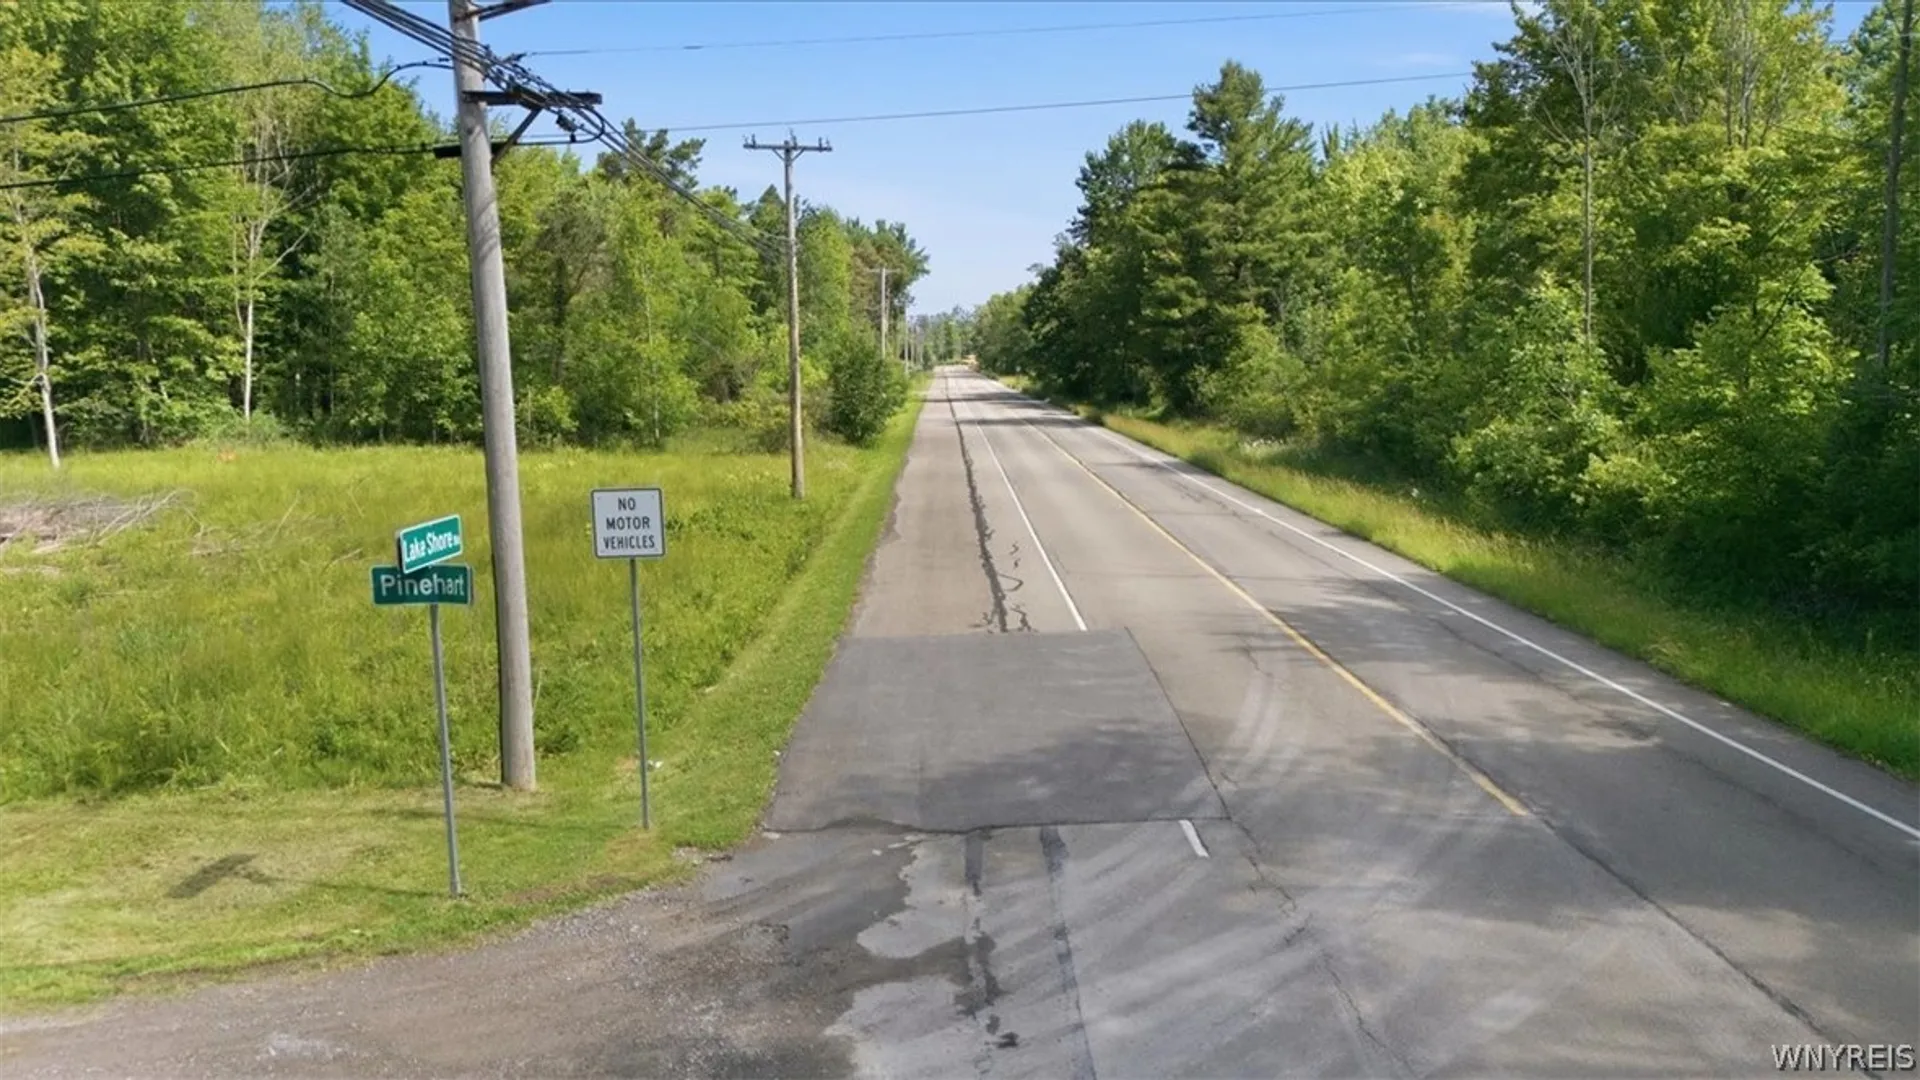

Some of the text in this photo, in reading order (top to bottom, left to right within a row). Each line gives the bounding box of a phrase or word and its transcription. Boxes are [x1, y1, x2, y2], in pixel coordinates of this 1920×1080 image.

[618, 497, 636, 511] NO
[606, 516, 650, 531] MOTOR
[403, 537, 426, 562] Lake
[426, 531, 453, 555] Shore
[603, 535, 655, 549] VEHICLES
[380, 572, 465, 597] Pinehart
